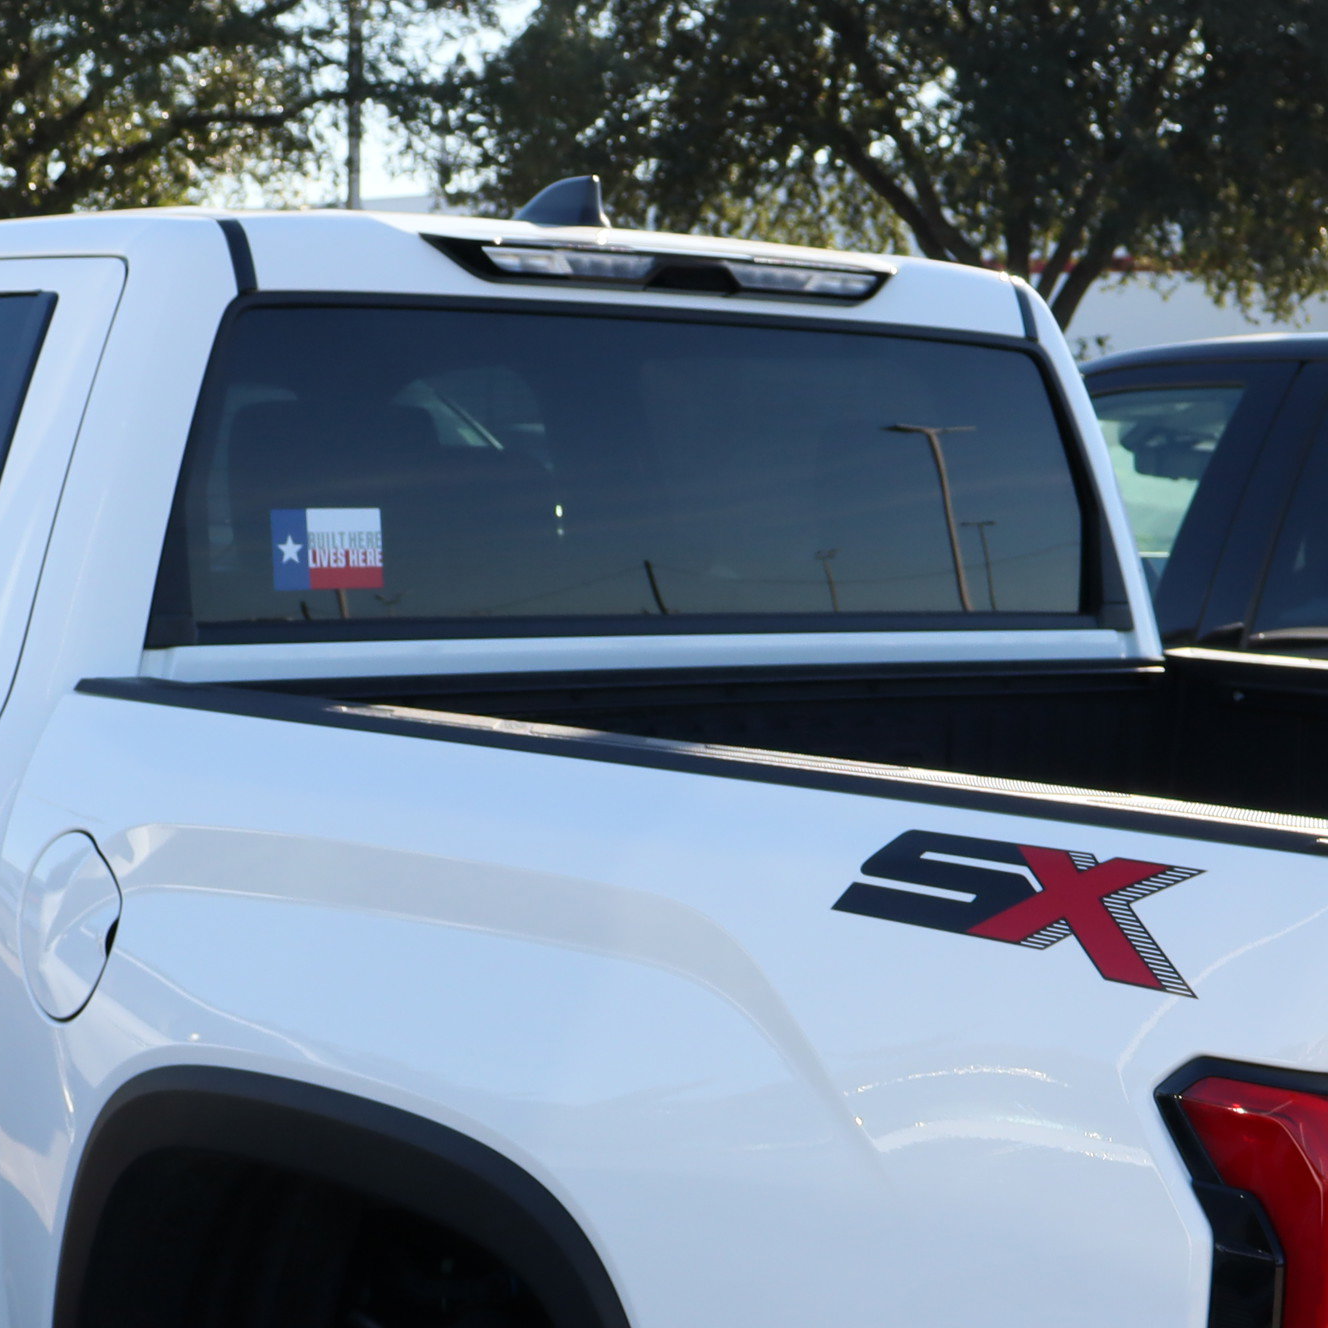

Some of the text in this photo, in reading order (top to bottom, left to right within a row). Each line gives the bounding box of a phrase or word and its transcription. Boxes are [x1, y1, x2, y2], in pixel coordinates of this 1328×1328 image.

[308, 531, 382, 550] BUILT HERE
[308, 549, 383, 568] LIVES HERE
[831, 828, 1207, 1000] SX
